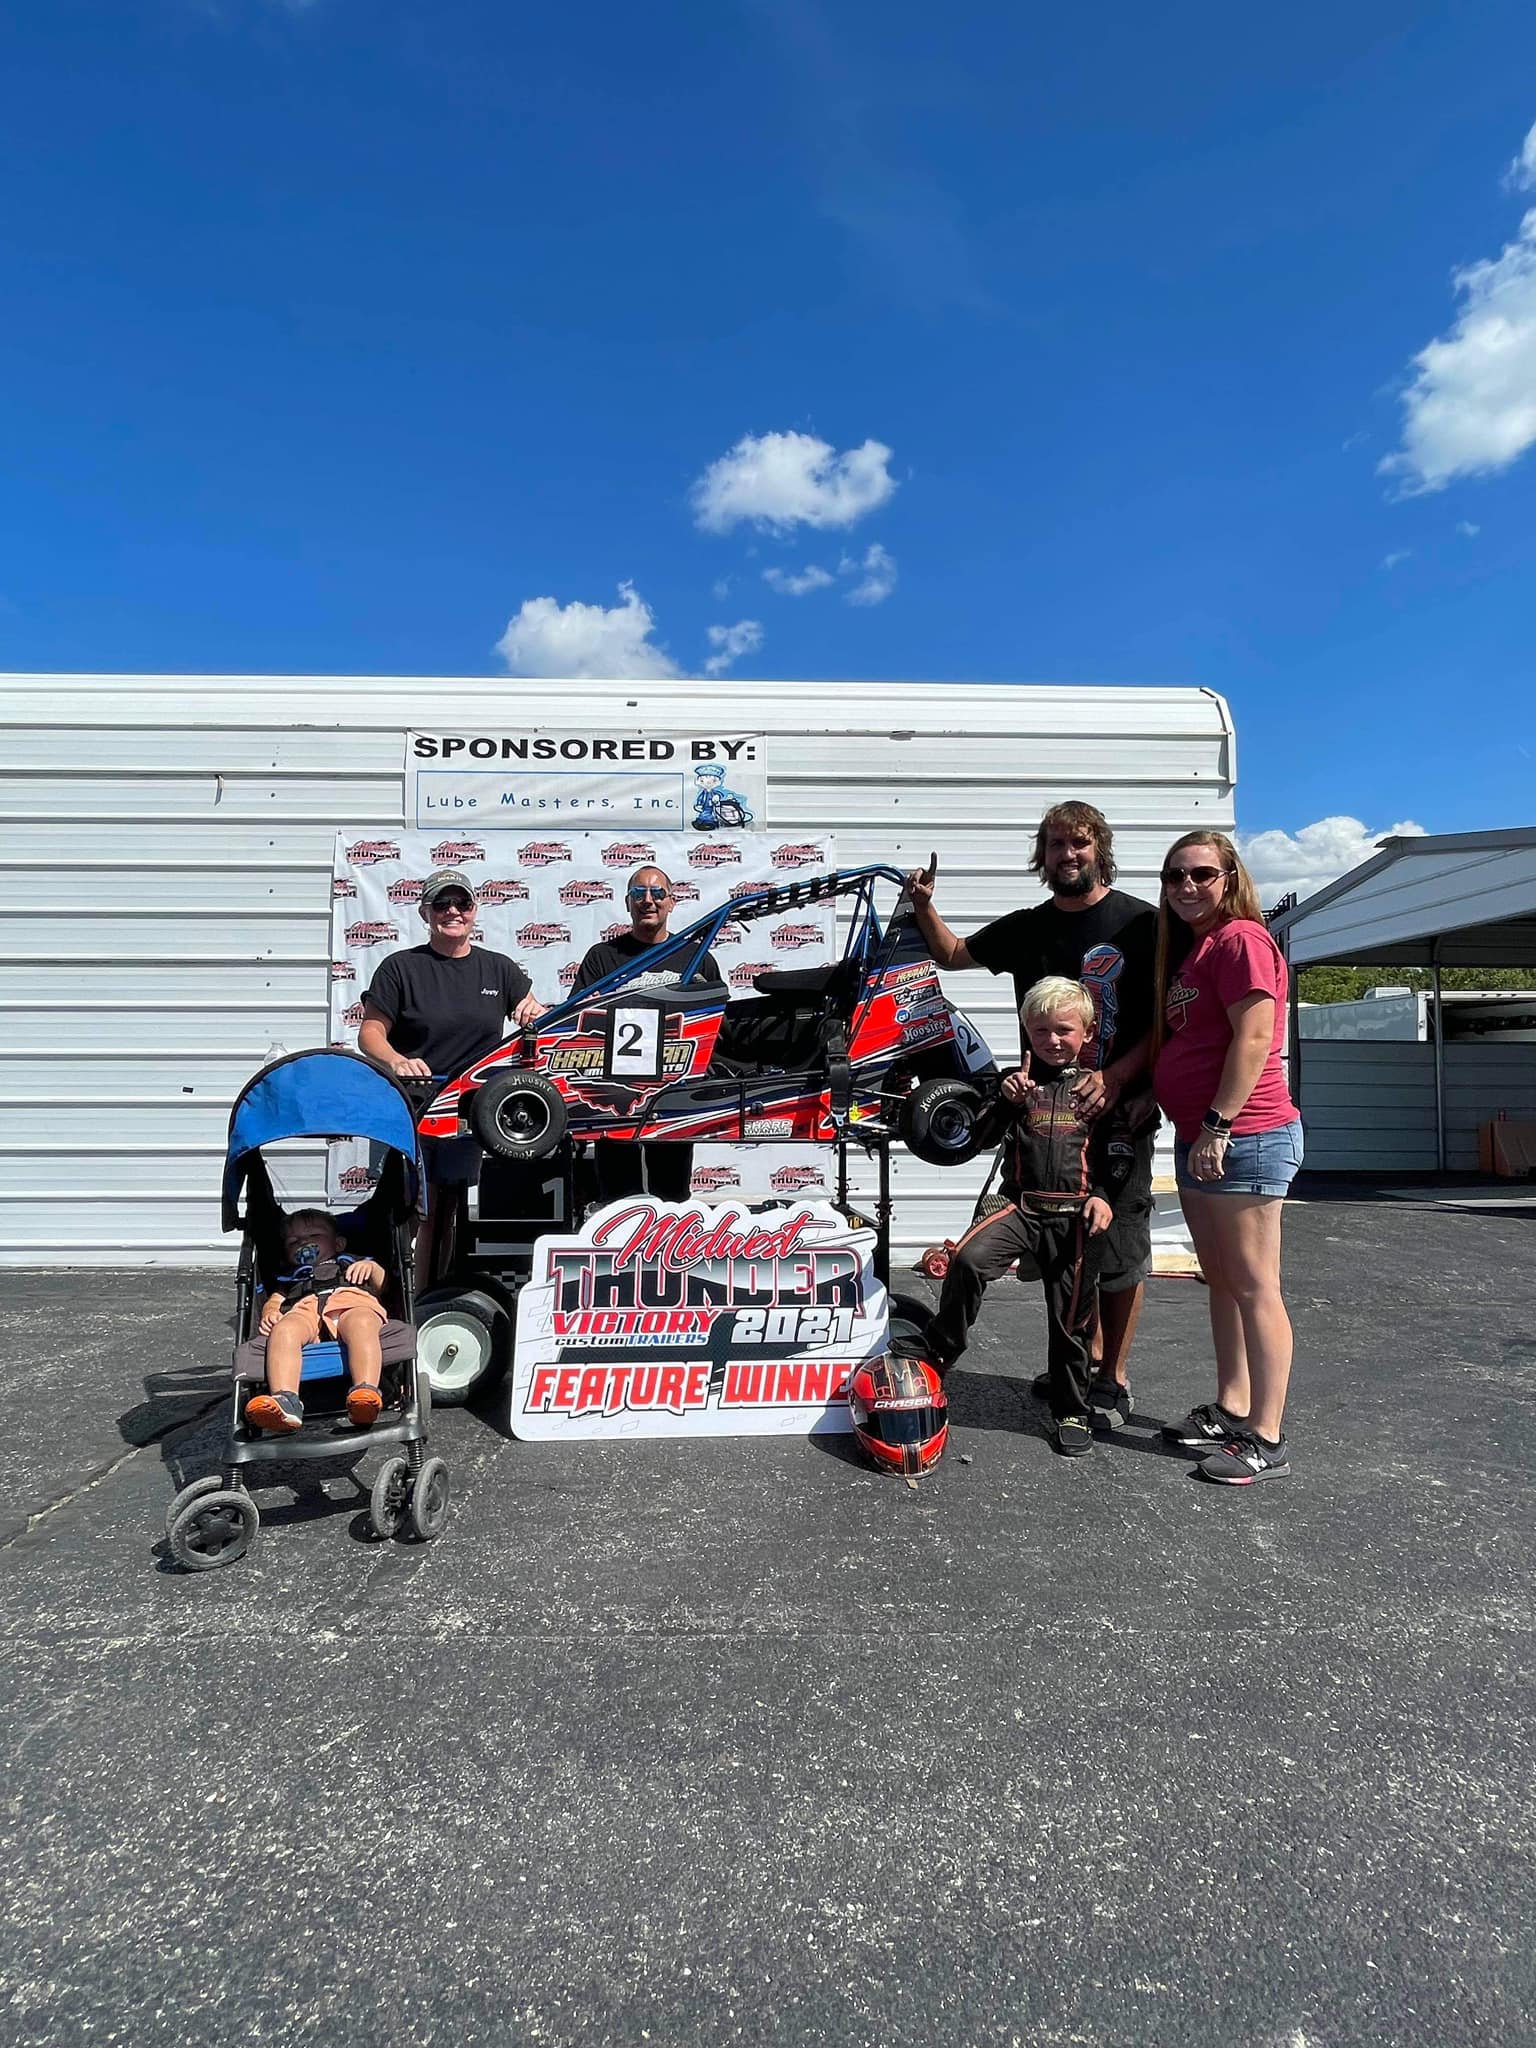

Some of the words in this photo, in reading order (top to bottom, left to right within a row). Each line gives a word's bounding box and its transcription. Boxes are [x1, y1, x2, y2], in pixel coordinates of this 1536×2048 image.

[413, 736, 675, 761] SPONSORED
[690, 740, 756, 761] BY:
[426, 794, 478, 809] Lube
[500, 792, 616, 809] Masters,
[632, 796, 680, 809] Inc.
[616, 1023, 643, 1057] 2
[957, 1025, 981, 1056] 2
[592, 1204, 836, 1273] Midwest
[549, 1248, 866, 1319] THUNDER
[552, 1310, 718, 1334] VICTORY
[732, 1308, 854, 1344] 2021
[528, 1366, 710, 1411] FEATURE
[722, 1363, 852, 1402] WINNE
[873, 1396, 933, 1409] CHASEN
